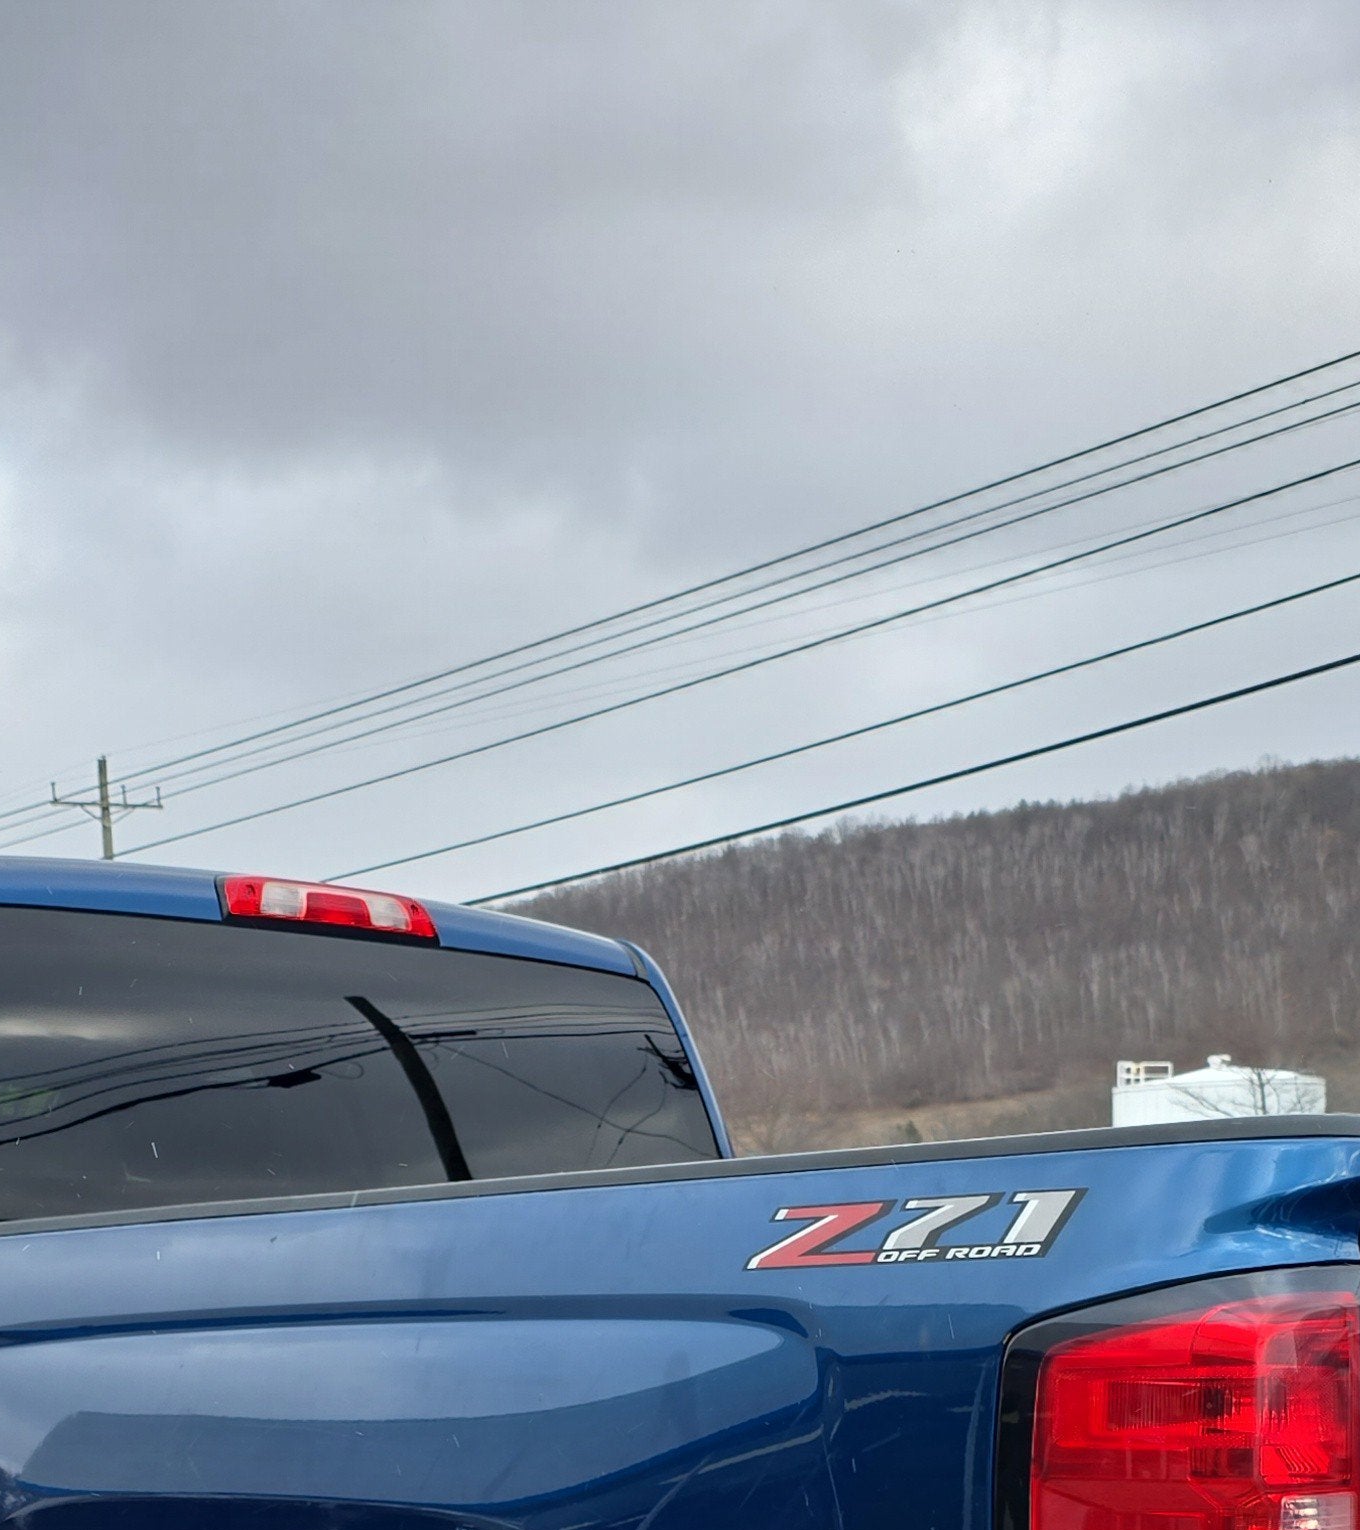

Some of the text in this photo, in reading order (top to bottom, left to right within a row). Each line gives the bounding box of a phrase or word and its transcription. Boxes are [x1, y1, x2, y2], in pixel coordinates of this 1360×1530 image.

[742, 1187, 1089, 1272] Z71
[876, 1243, 1042, 1263] OFF ROAD
